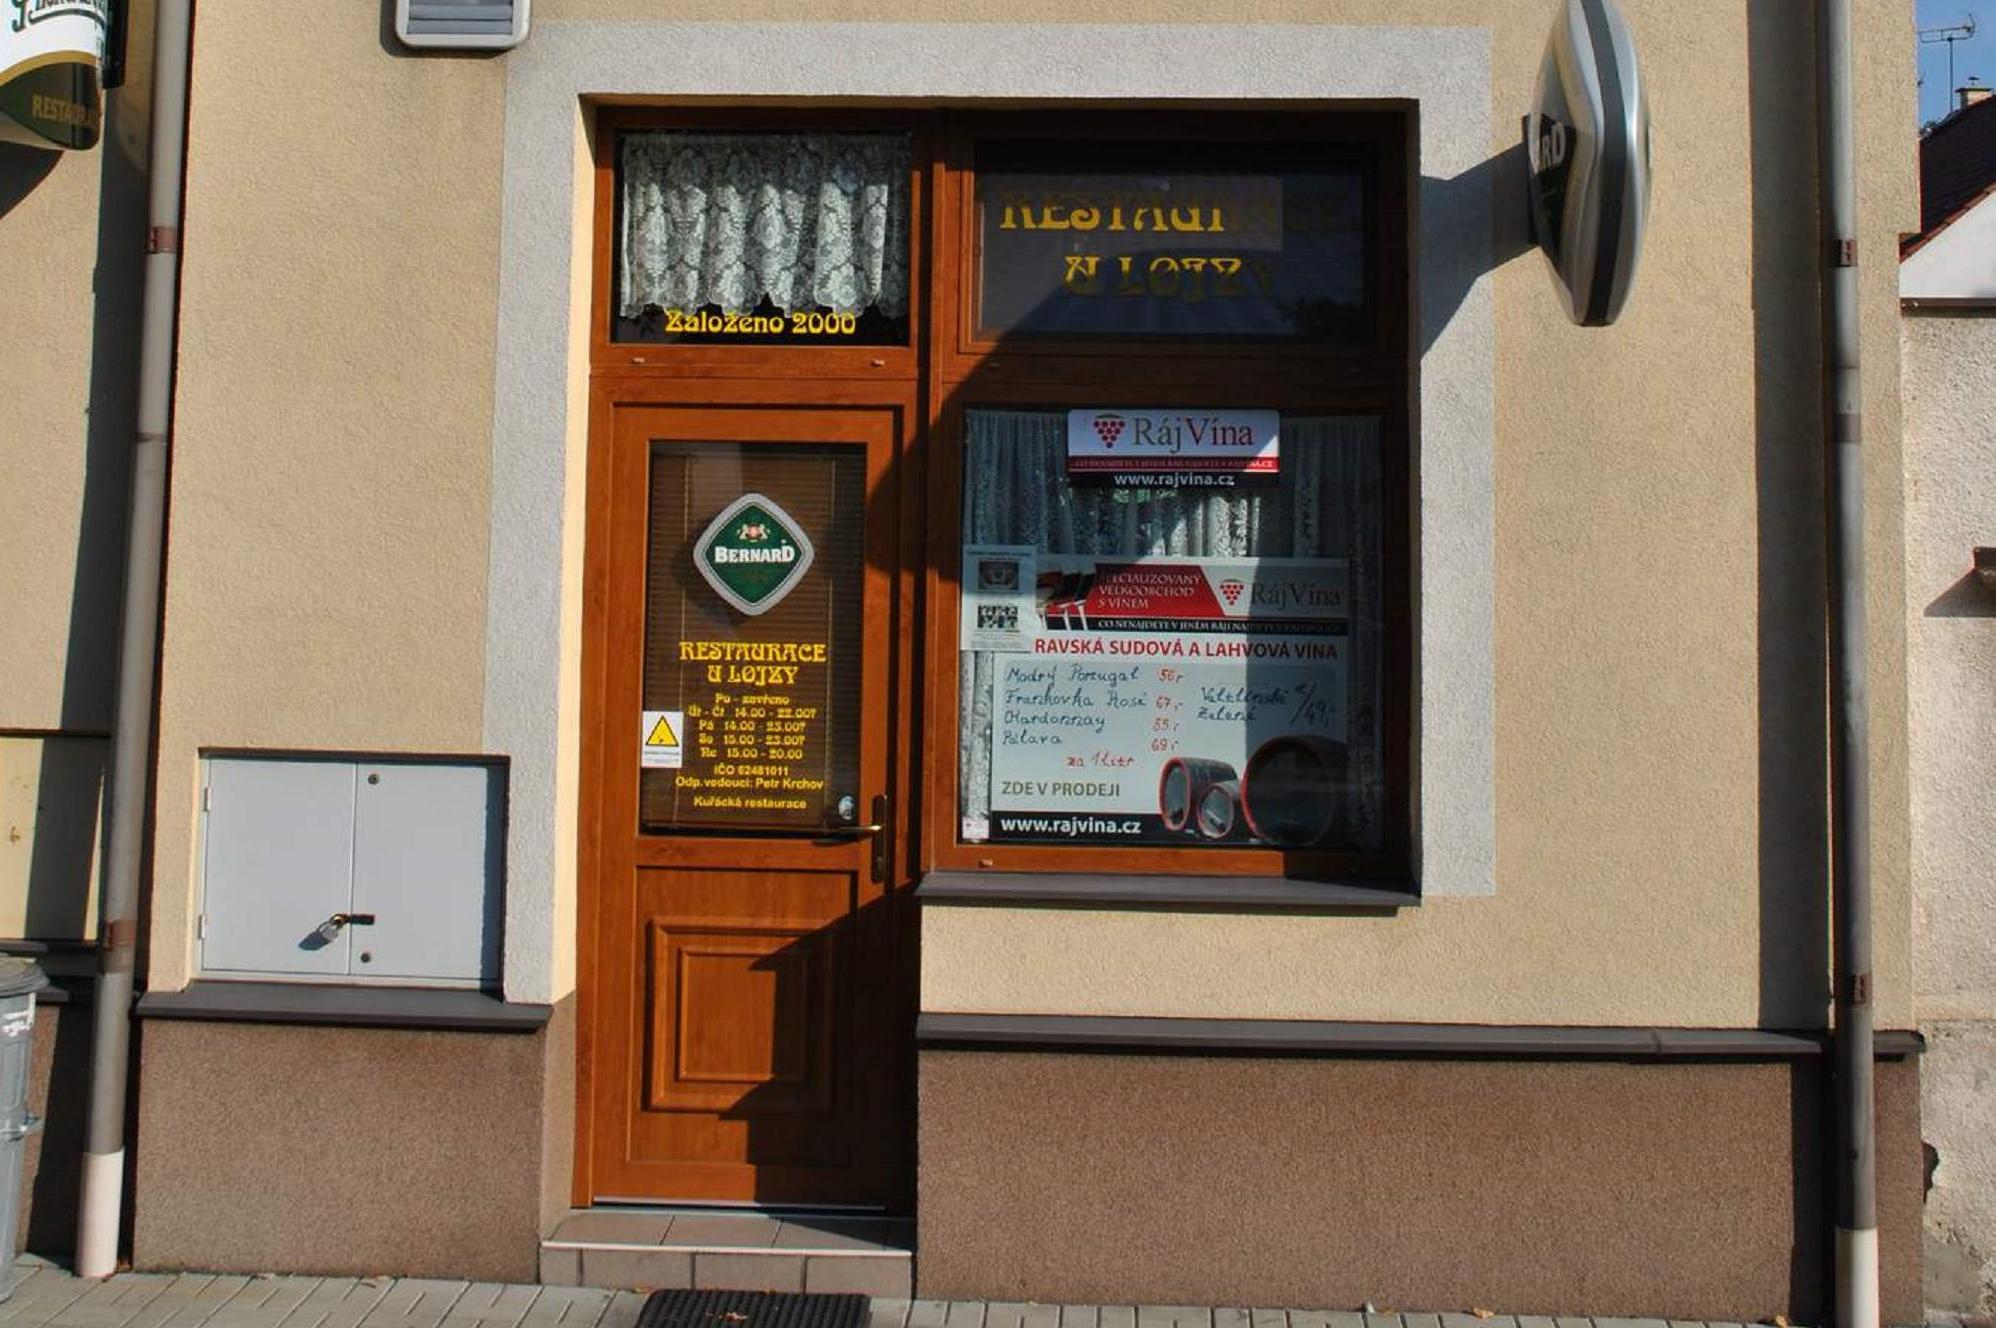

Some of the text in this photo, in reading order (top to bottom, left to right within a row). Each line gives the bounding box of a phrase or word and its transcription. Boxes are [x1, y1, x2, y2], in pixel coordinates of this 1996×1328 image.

[664, 309, 857, 335] Založeno 2000
[713, 544, 796, 564] BERNARD
[679, 641, 827, 663] RESTAURACE
[1034, 637, 1103, 655] RAVSKÁ
[1109, 638, 1184, 657] SUDOVÁ
[1188, 640, 1200, 657] A
[1205, 638, 1292, 659] LAHVOVÁ
[1295, 640, 1339, 659] VÍNA
[707, 665, 799, 687] U LOJZY
[715, 693, 731, 704] Po
[755, 777, 780, 788] Petr
[1001, 781, 1121, 798] ZDE V PRODEJI
[744, 797, 808, 809] restaurace
[1001, 815, 1142, 836] www.rajvina.cz
